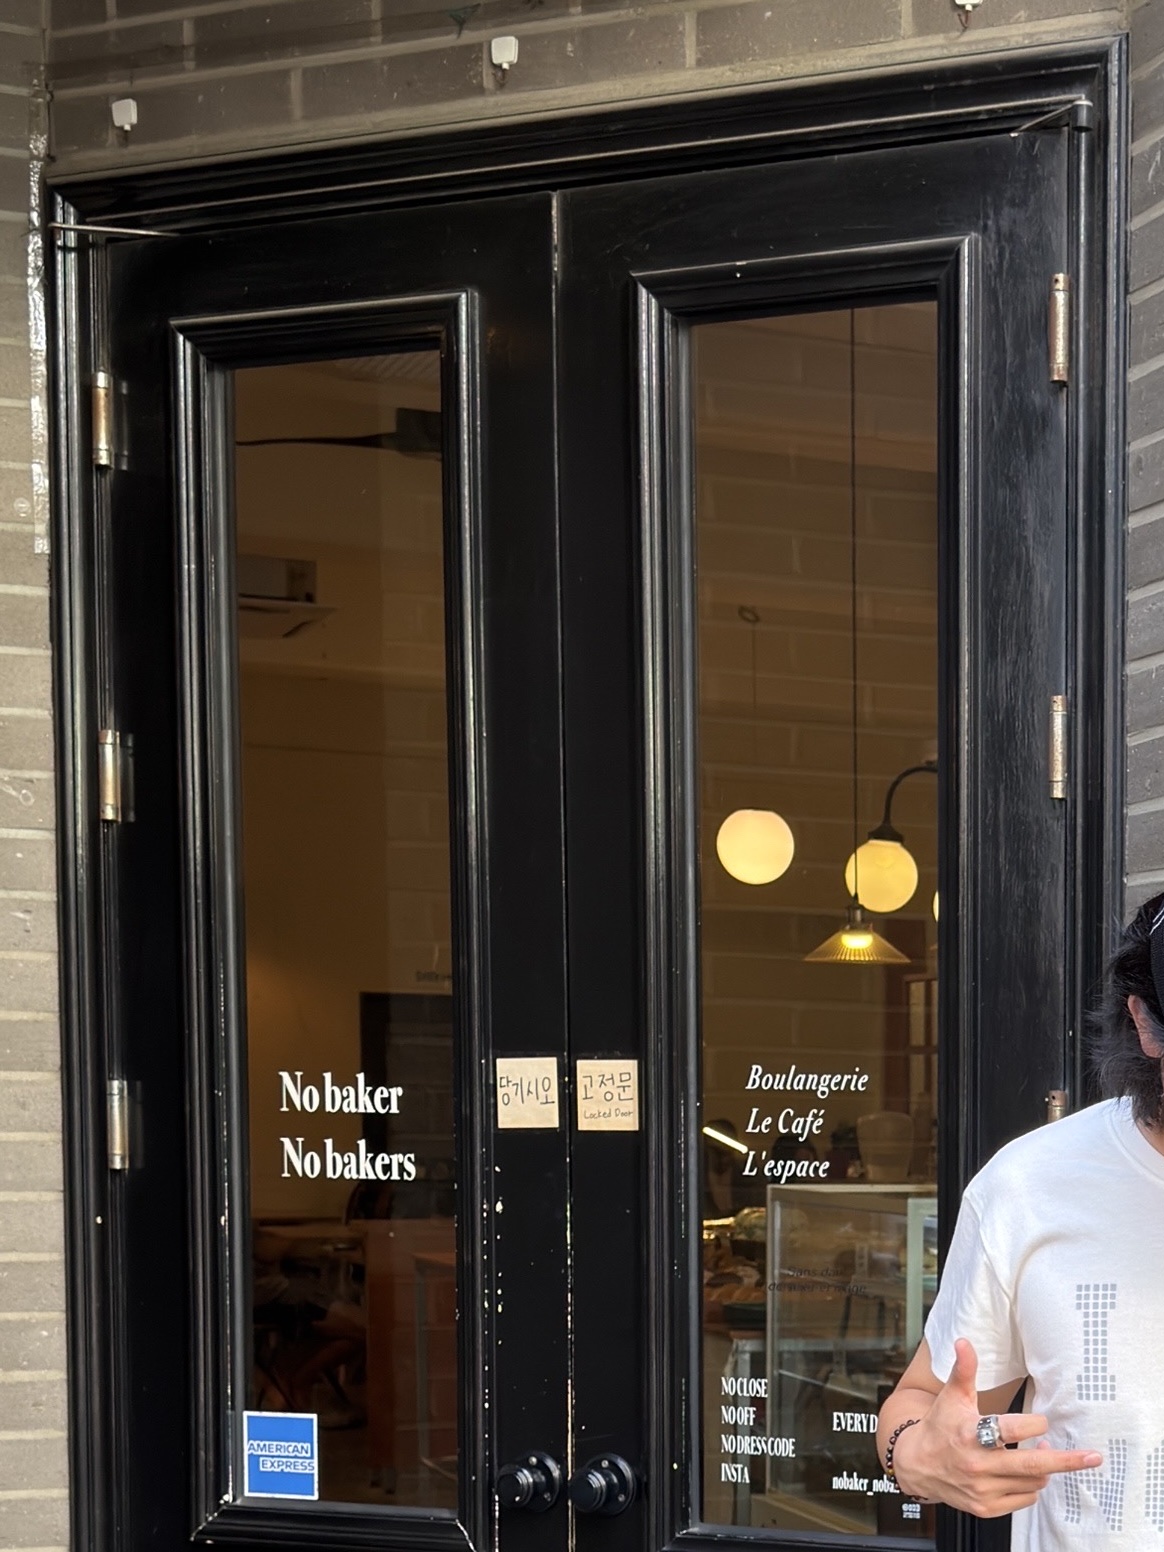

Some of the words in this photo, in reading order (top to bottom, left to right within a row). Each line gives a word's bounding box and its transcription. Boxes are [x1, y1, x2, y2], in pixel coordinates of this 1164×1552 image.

[278, 1071, 319, 1114] No
[323, 1072, 404, 1115] baker
[499, 1075, 555, 1106] 당기시오
[582, 1072, 634, 1102] 고정문
[745, 1065, 869, 1098] Boulangerie
[583, 1107, 612, 1120] Locked
[615, 1107, 634, 1118] Door
[745, 1108, 772, 1134] Le
[777, 1108, 825, 1142] Café
[280, 1137, 321, 1179] No
[325, 1138, 417, 1181] bakers
[742, 1151, 830, 1184] L'espace
[721, 1377, 736, 1396] NO
[737, 1377, 768, 1398] CLOSE
[721, 1406, 736, 1425] NO
[736, 1406, 757, 1426] OFF
[247, 1440, 311, 1456] AMERICAN
[721, 1434, 736, 1453] NO
[737, 1435, 767, 1456] DRESS
[767, 1438, 796, 1458] CODE
[260, 1458, 315, 1473] EXPRESS
[721, 1463, 750, 1484] INSTA
